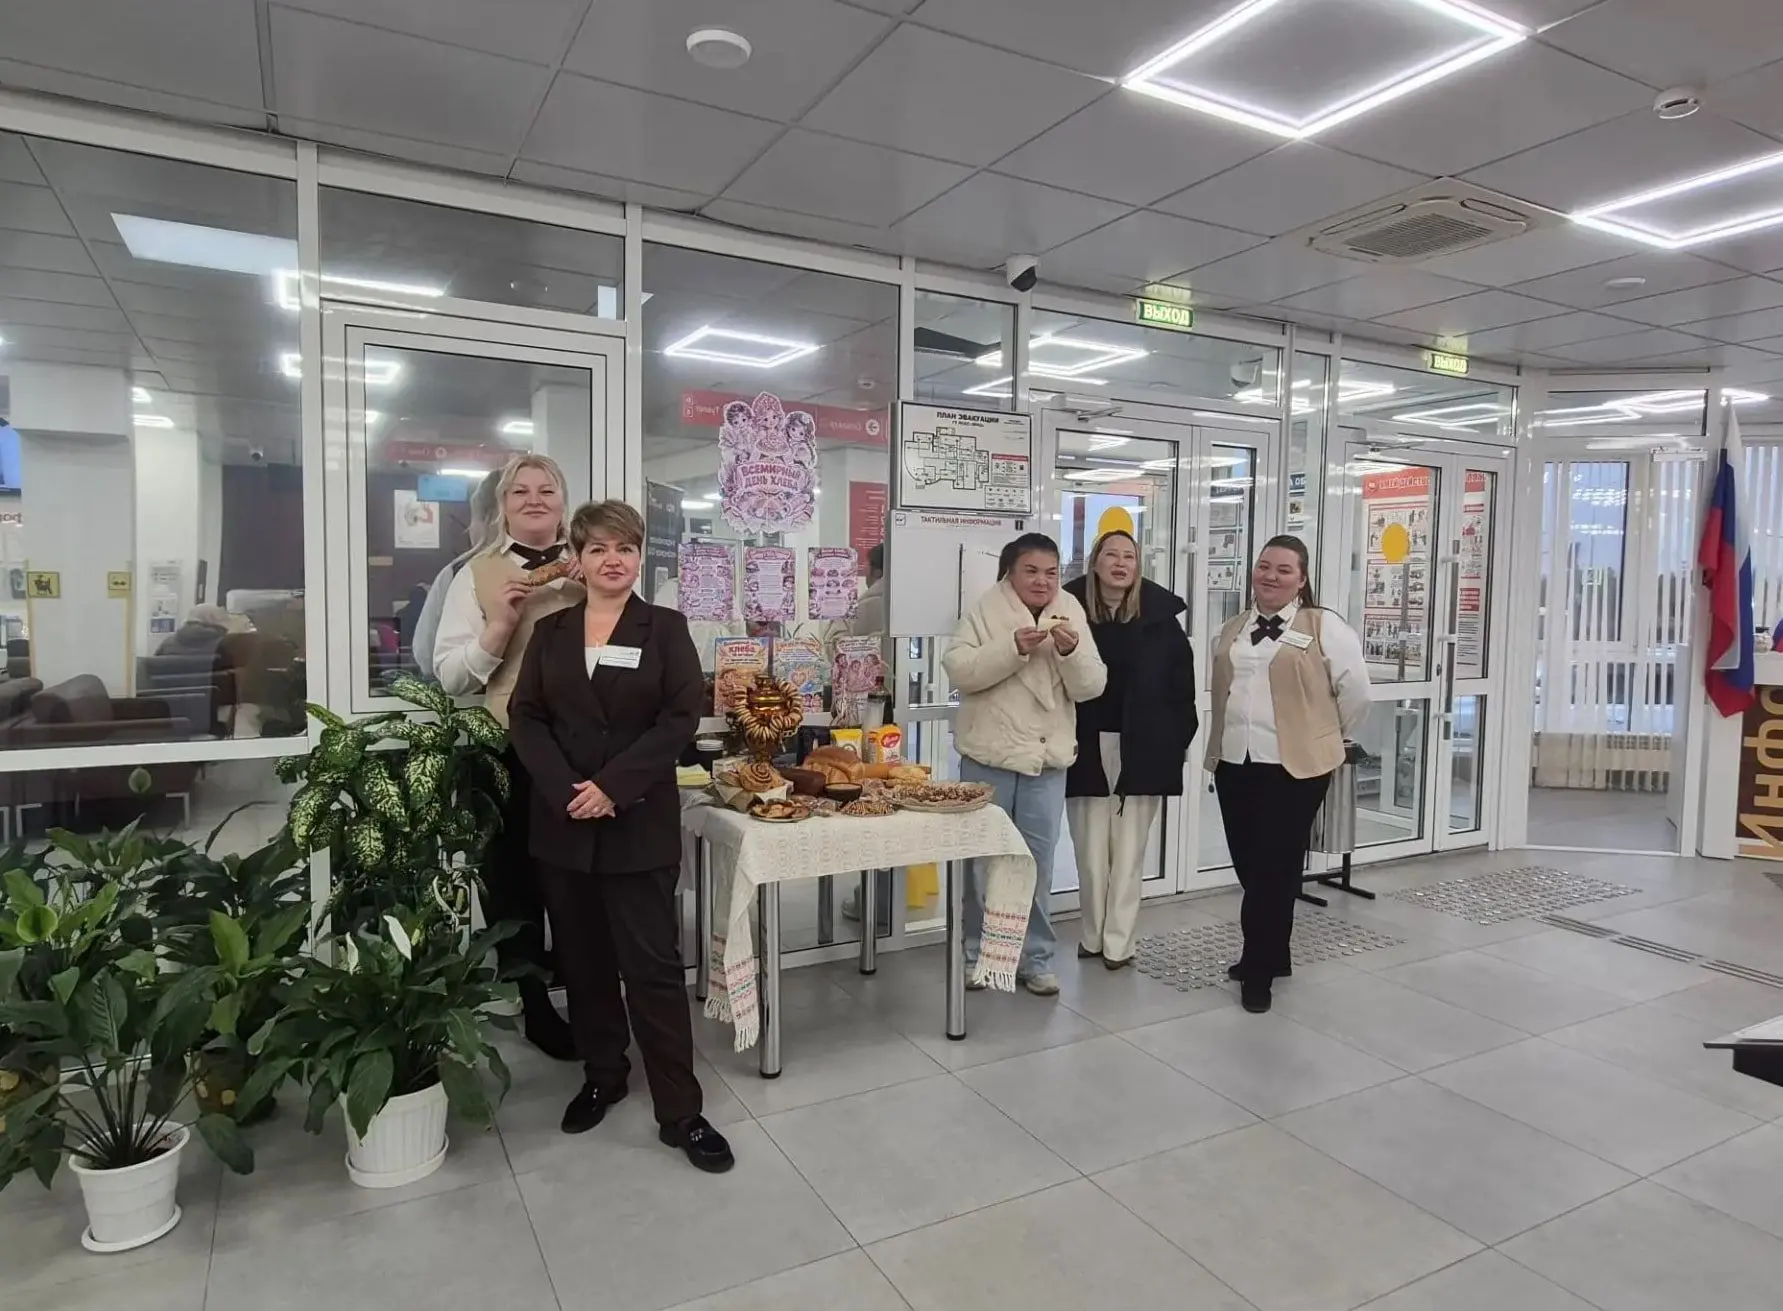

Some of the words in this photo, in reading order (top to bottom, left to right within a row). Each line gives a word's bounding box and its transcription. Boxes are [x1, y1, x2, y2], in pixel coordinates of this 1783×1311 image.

[1144, 303, 1190, 326] ВЫХОД
[1434, 355, 1467, 373] ВЫХОД
[936, 411, 956, 420] ПЛАН
[957, 414, 999, 423] ЭВАКУАЦИИ
[741, 464, 801, 479] ВСЕМИРНЫЙ
[745, 475, 768, 488] ДЕНЬ
